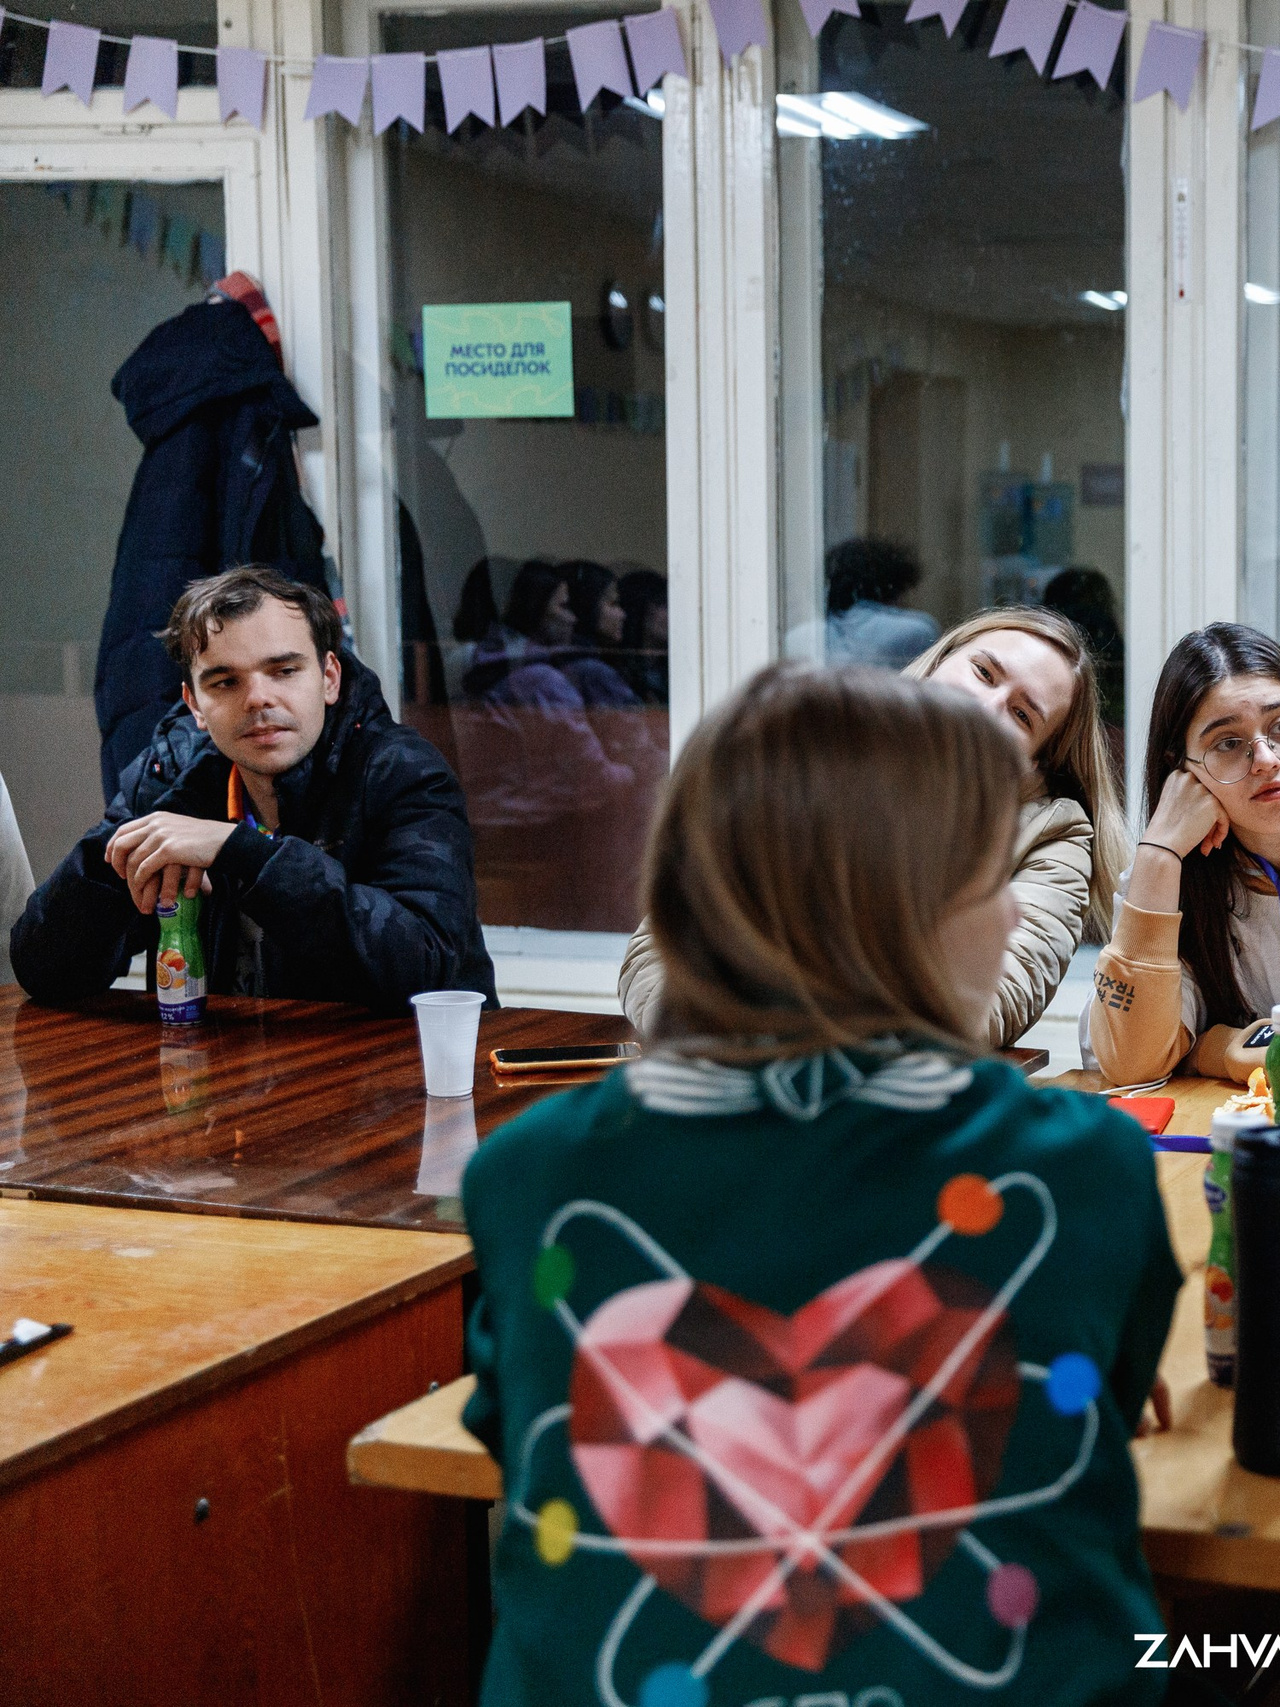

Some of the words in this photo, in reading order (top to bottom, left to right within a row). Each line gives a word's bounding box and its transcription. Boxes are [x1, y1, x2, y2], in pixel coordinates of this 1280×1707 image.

[450, 343, 506, 359] МЕСТО
[510, 341, 546, 358] ДЛЯ
[445, 360, 551, 377] ПОСИДЕЛОК
